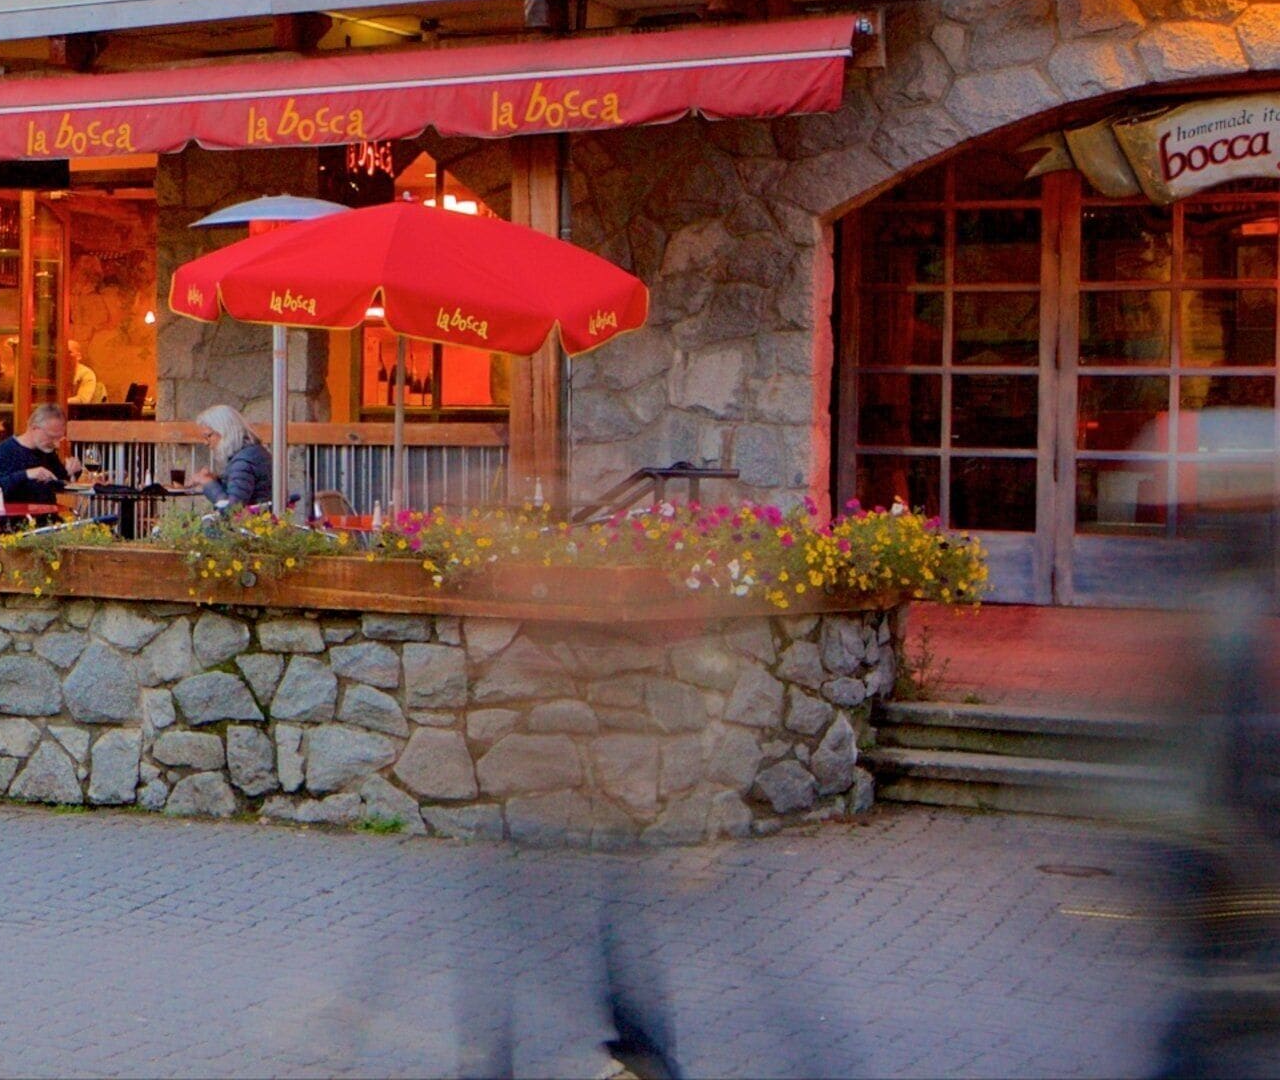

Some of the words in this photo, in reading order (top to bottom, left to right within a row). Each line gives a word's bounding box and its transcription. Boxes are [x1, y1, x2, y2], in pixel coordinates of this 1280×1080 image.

[247, 107, 272, 144] la
[492, 90, 518, 132] la
[1176, 109, 1254, 142] homemade
[26, 121, 50, 156] la
[1159, 130, 1272, 185] bocca
[269, 290, 283, 315] la
[436, 307, 450, 332] la
